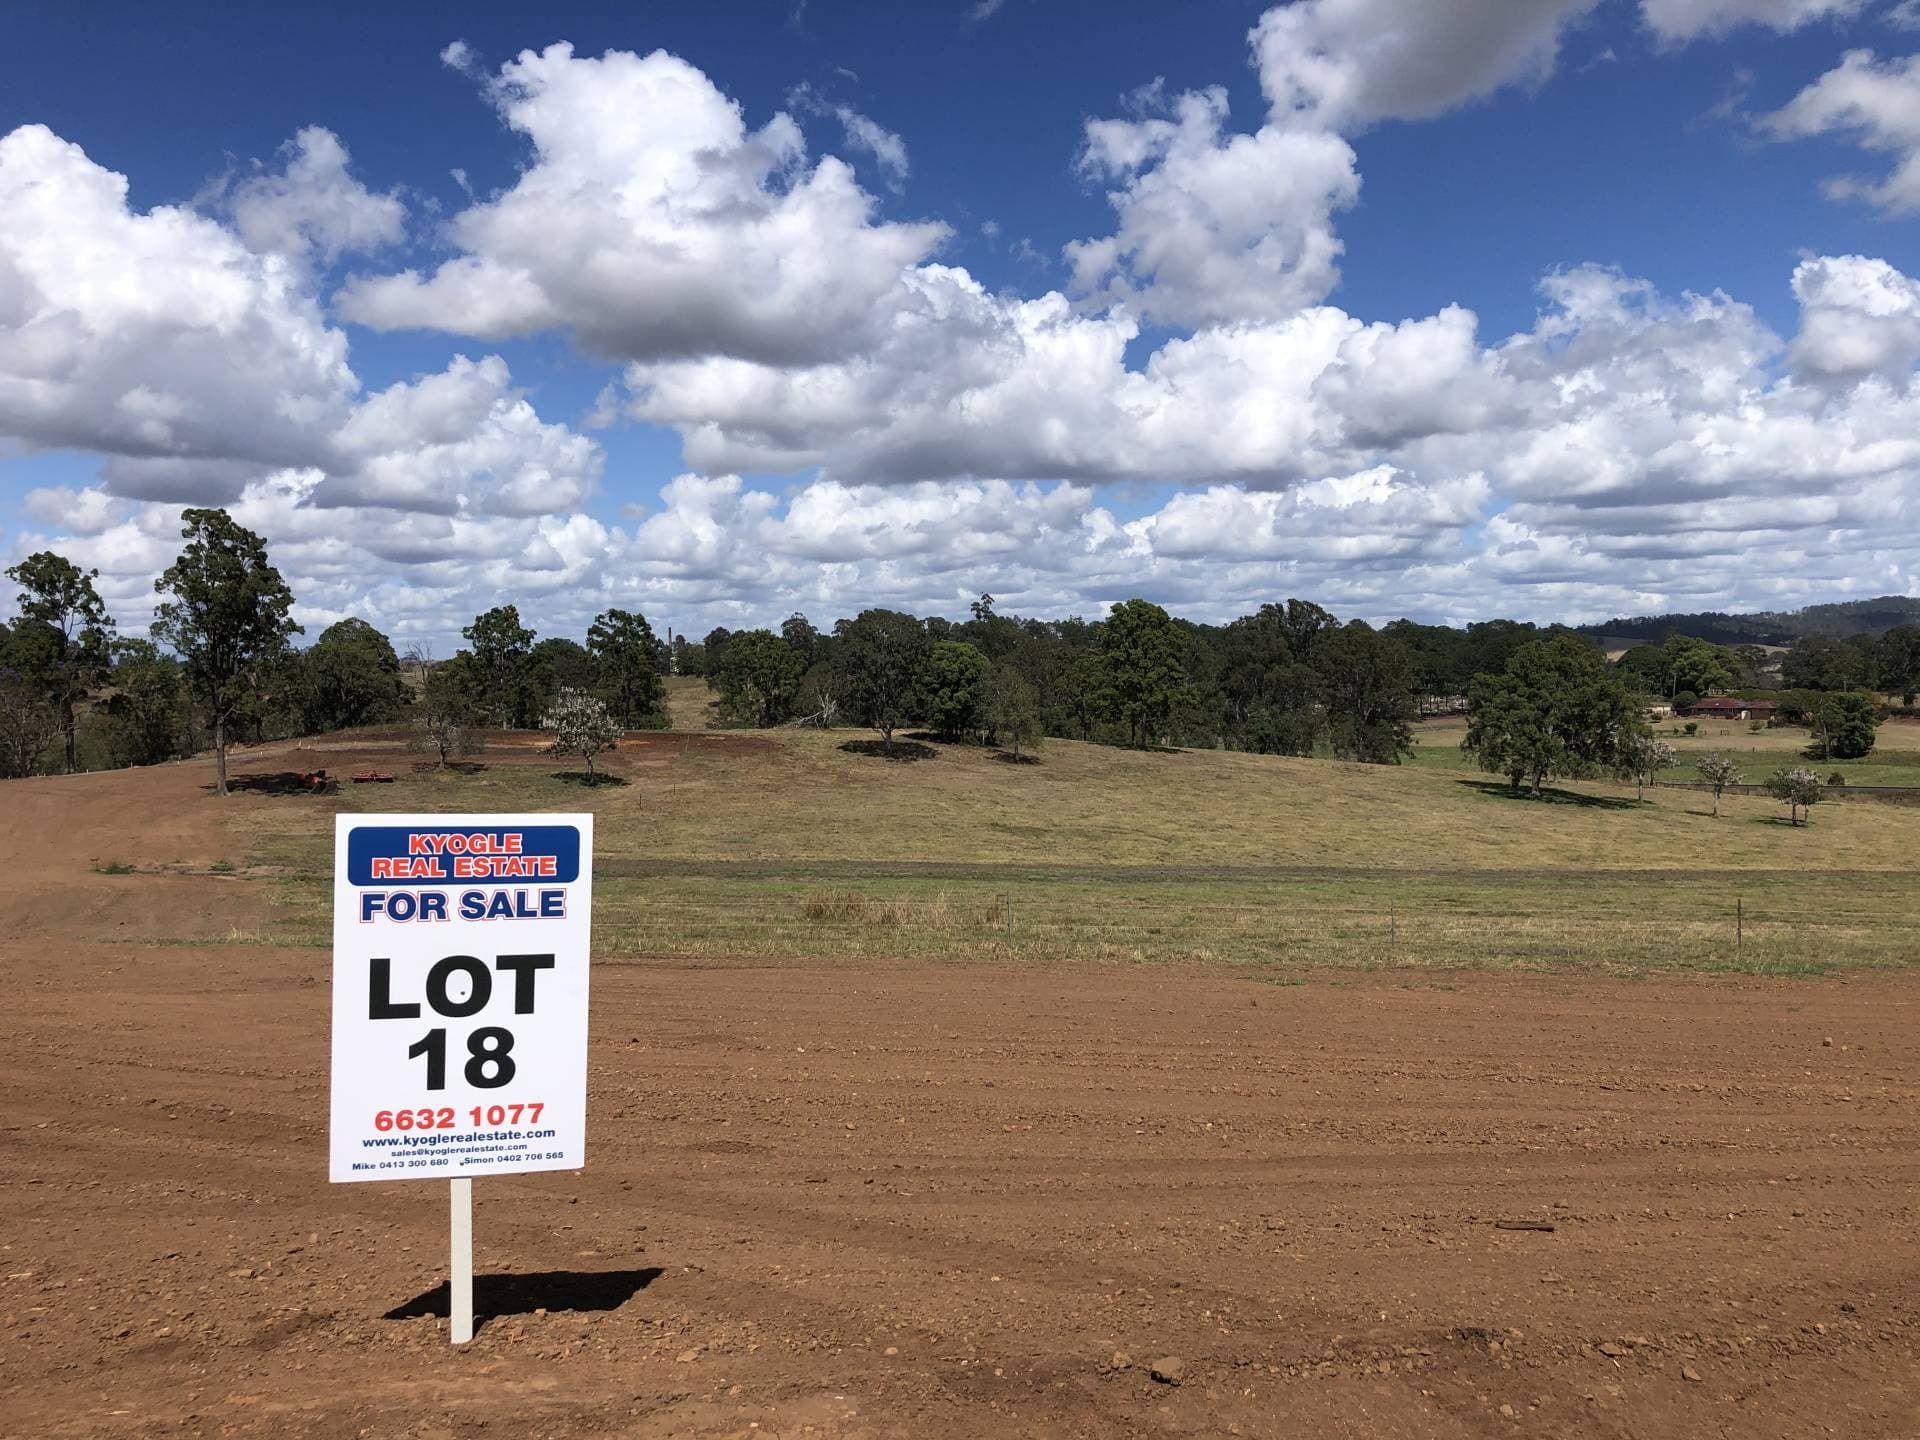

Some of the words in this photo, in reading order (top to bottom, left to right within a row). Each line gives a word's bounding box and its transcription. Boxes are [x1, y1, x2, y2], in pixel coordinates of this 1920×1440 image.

[408, 833, 523, 855] KYOGLE
[371, 857, 446, 878] REAL
[454, 856, 557, 878] ESTATE
[360, 890, 451, 923] FOR
[458, 888, 567, 921] SALE
[369, 953, 555, 1019] LOT
[408, 1027, 517, 1091] 18
[374, 1108, 455, 1132] 6632
[470, 1103, 545, 1127] 1077
[362, 1128, 556, 1148] www.kyoglerealestate.com
[352, 1162, 376, 1171] Mike
[379, 1160, 405, 1169] 0413
[408, 1159, 427, 1168] 300
[430, 1158, 449, 1167] 680
[464, 1156, 494, 1165] Simon
[497, 1154, 522, 1163] 0402
[524, 1153, 543, 1162] 706
[546, 1151, 564, 1160] 565
[391, 1143, 527, 1159] sales@kyoglerealestate.com
